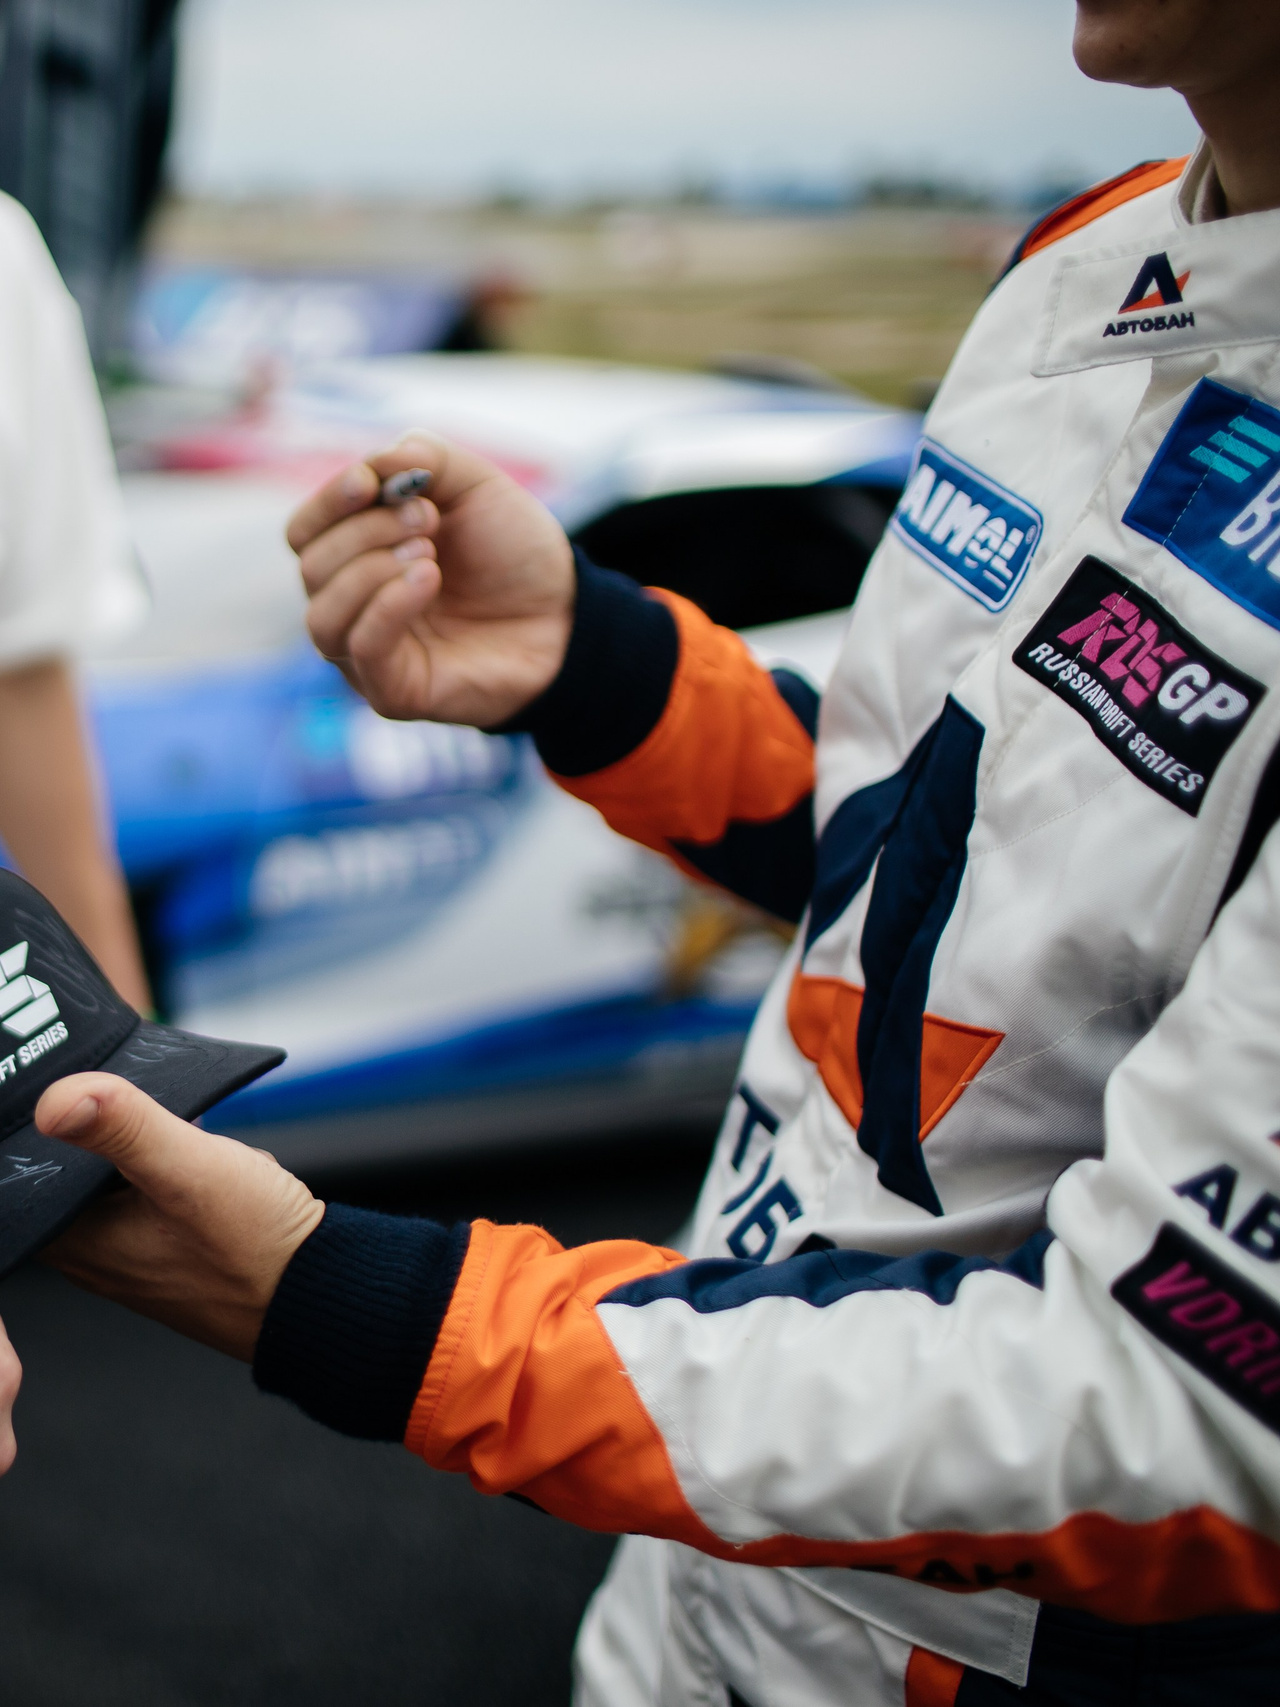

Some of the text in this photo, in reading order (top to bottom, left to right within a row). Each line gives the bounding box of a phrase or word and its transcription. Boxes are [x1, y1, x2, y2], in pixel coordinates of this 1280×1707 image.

[1102, 311, 1195, 338] АВТОБАН
[899, 463, 1024, 591] AIMOL
[1028, 642, 1205, 793] RUSSIAN DRIFT SERIES
[18, 1020, 69, 1066] SERIES
